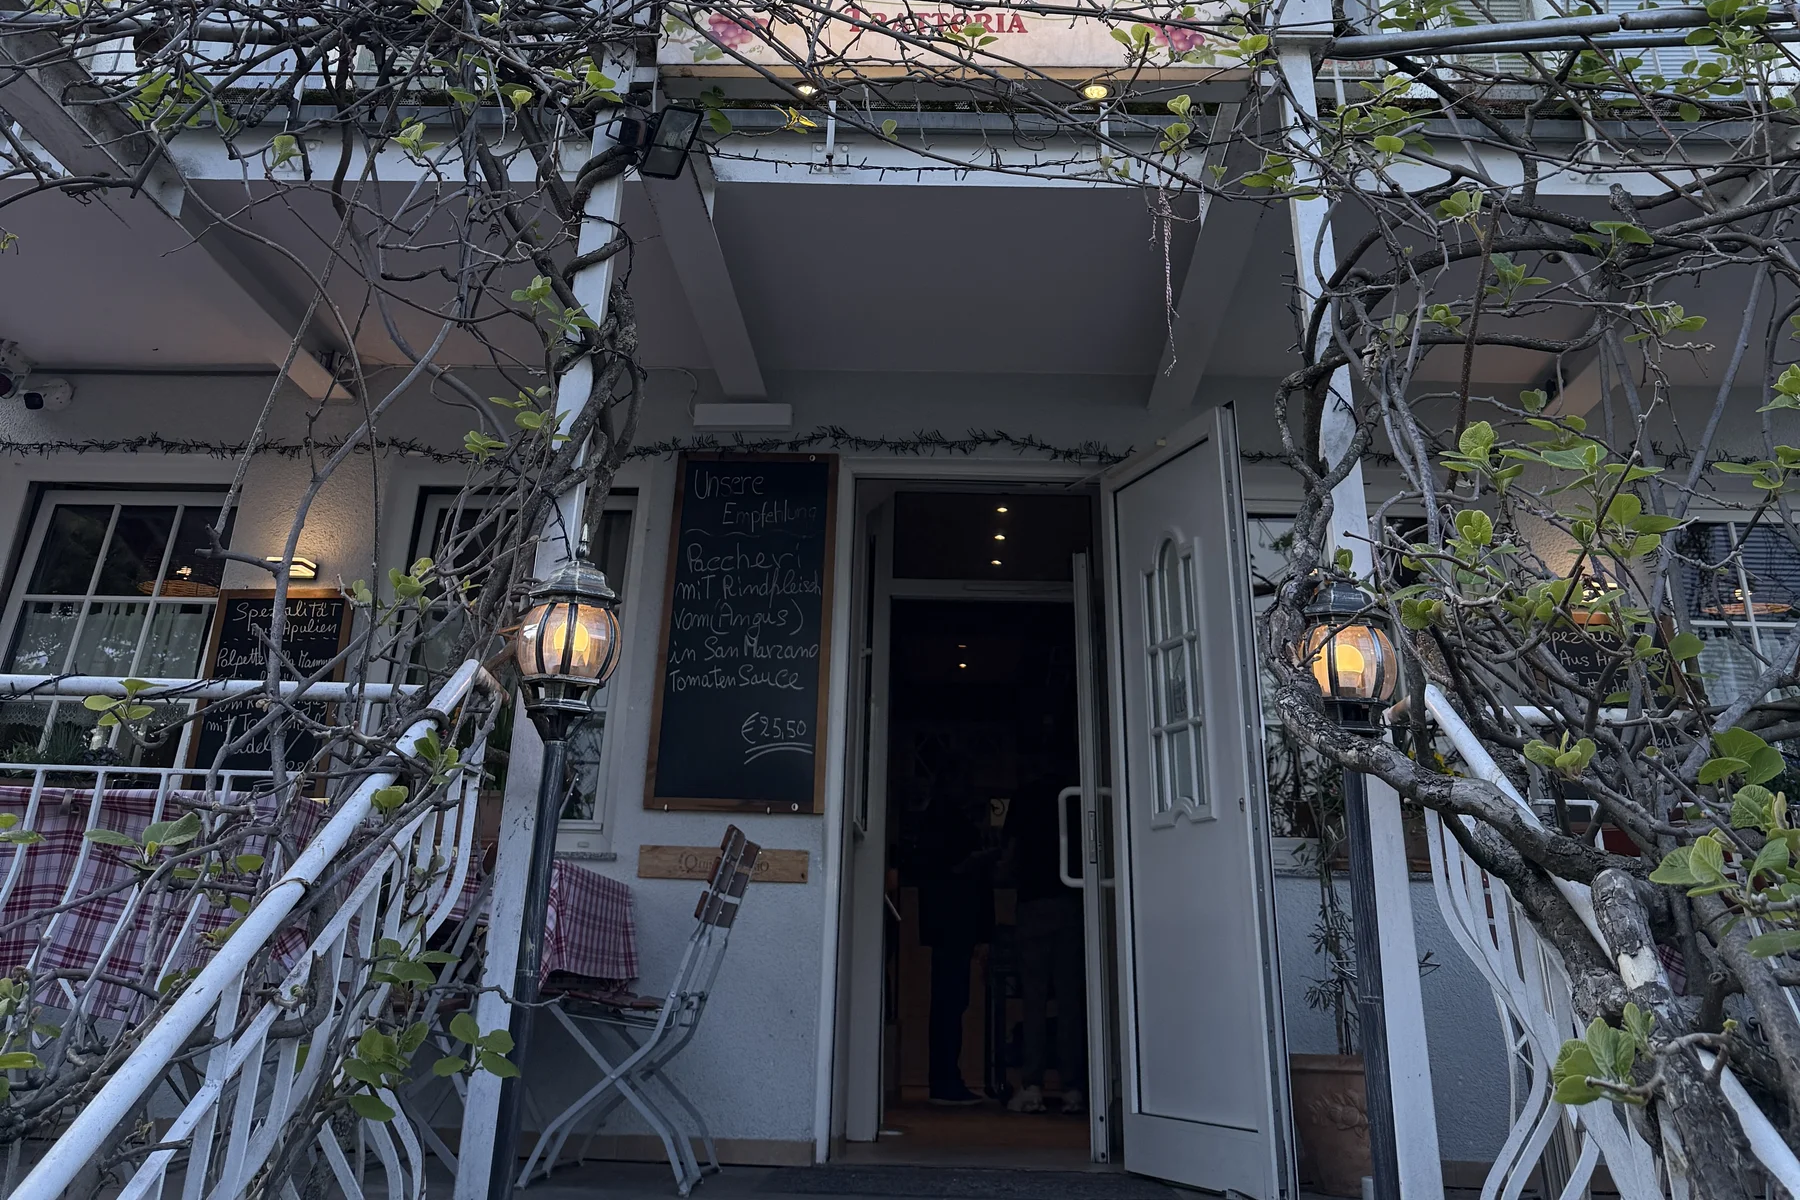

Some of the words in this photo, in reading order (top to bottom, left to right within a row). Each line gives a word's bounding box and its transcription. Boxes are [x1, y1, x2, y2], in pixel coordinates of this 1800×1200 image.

[694, 469, 765, 500] Unsere
[686, 542, 802, 573] Paccheri
[282, 618, 338, 643] Apulien
[216, 647, 265, 677] Polpette
[669, 641, 697, 665] in
[704, 636, 739, 662] San
[743, 635, 820, 660] Marzano
[1558, 649, 1590, 667] Aus
